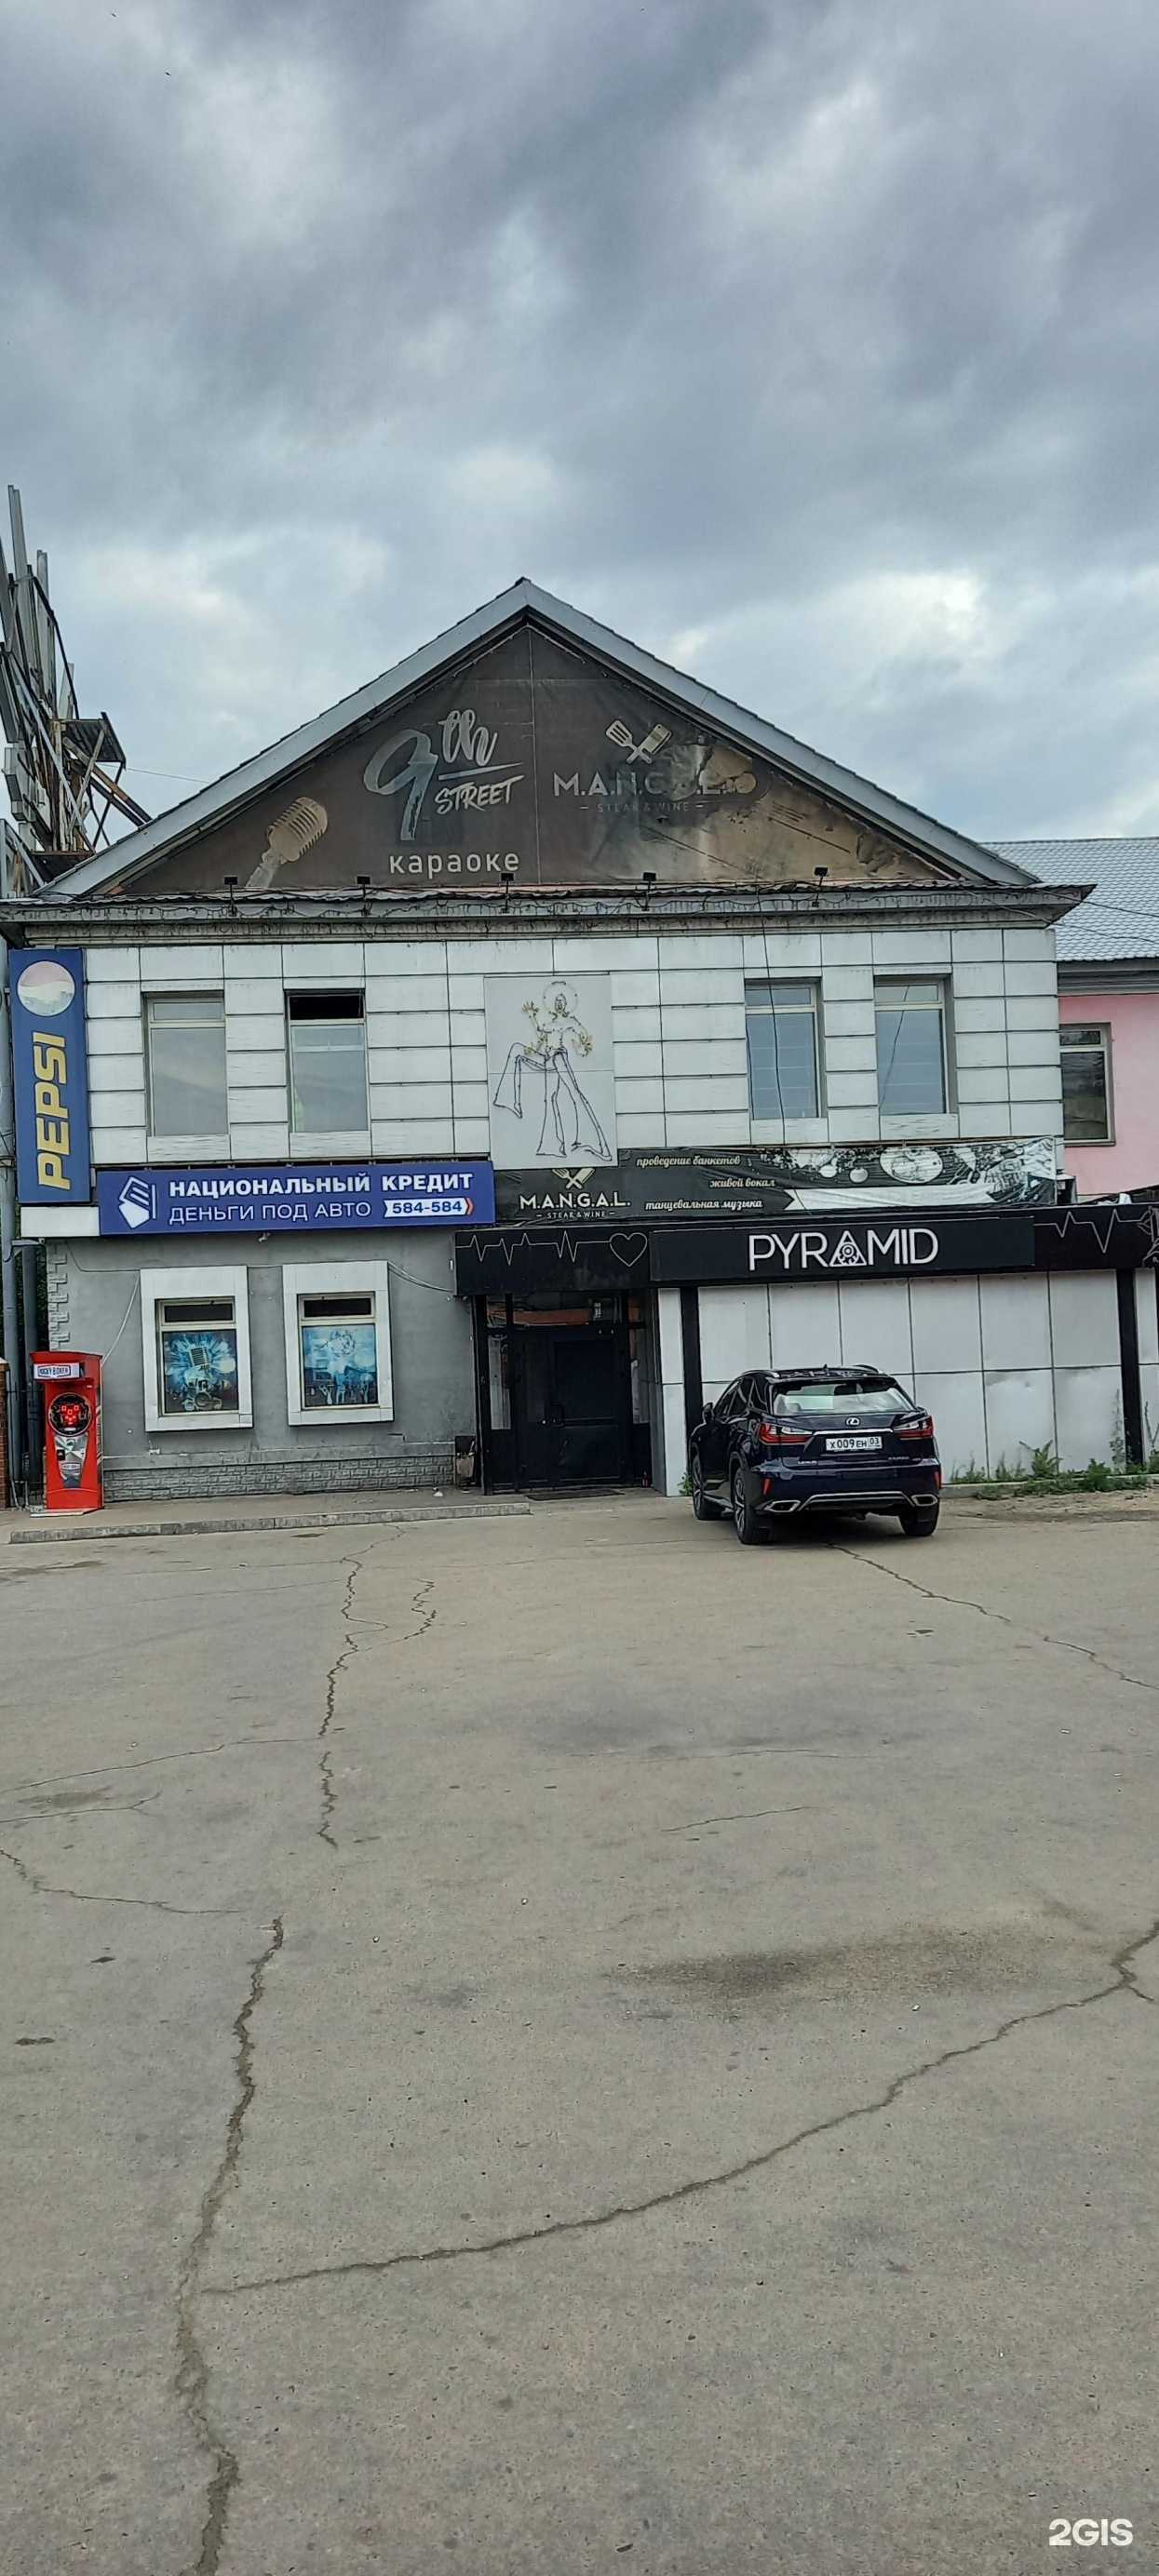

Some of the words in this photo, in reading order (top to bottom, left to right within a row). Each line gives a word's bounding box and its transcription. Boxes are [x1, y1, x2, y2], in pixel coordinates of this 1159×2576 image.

[434, 775, 525, 815] STREET
[389, 852, 519, 879] караоке
[33, 1031, 71, 1190] PEPSI
[637, 1154, 692, 1168] проведение
[693, 1154, 741, 1167] банкетов
[169, 1173, 371, 1199] НАЦИОНАЛЬНЫЙ
[382, 1174, 473, 1193] КРЕДИТ
[709, 1177, 744, 1188] живой
[745, 1177, 775, 1187] вокал
[392, 1201, 463, 1214] 584-584
[519, 1191, 631, 1210] M.A.N.G.A.L.
[645, 1199, 720, 1212] танцевальная
[721, 1200, 762, 1212] музыка
[169, 1205, 254, 1225] ДЕНЬГИ
[263, 1204, 308, 1222] ПОД
[314, 1201, 371, 1218] АВТО
[748, 1228, 939, 1271] PYRAMID
[869, 1437, 880, 1445] 03
